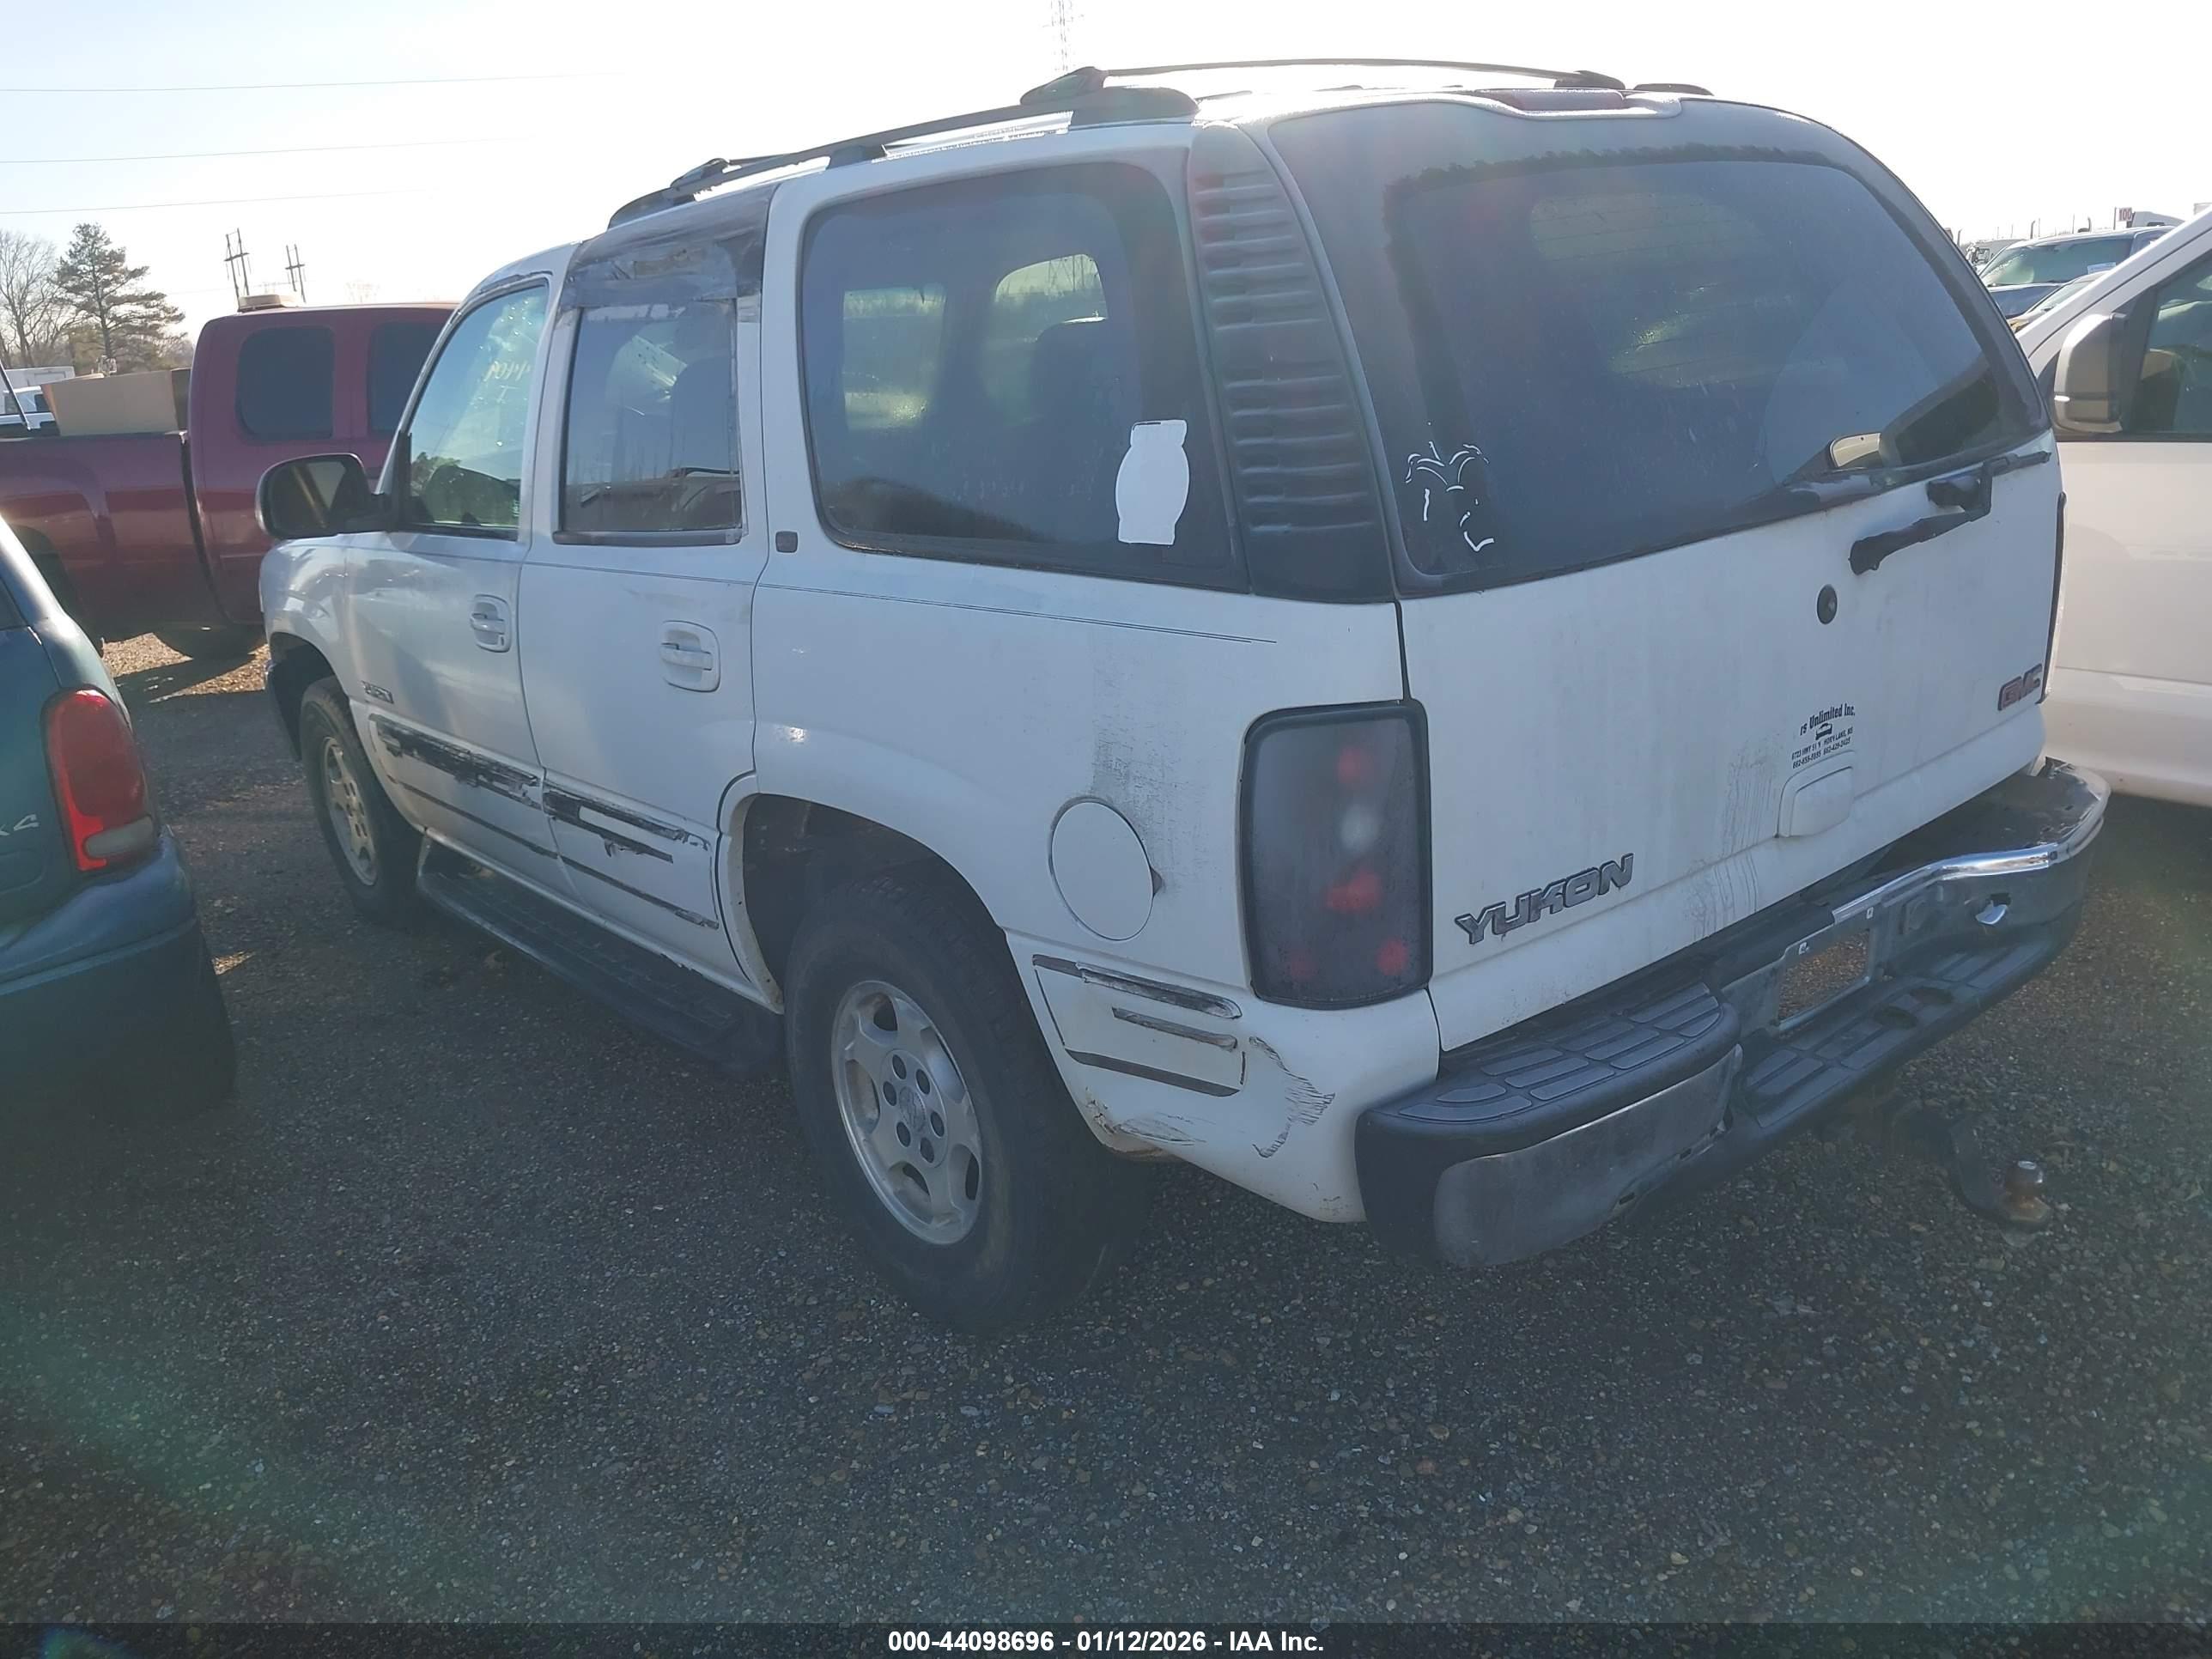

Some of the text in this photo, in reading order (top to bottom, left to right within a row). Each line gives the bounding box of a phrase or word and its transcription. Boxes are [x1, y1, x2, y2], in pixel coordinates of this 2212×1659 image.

[1997, 663, 2043, 711] GMC
[1809, 703, 1843, 729] Unlimited
[1844, 702, 1856, 717] Inc.
[1802, 744, 1812, 757] HWY
[1454, 853, 1634, 945] YUKON
